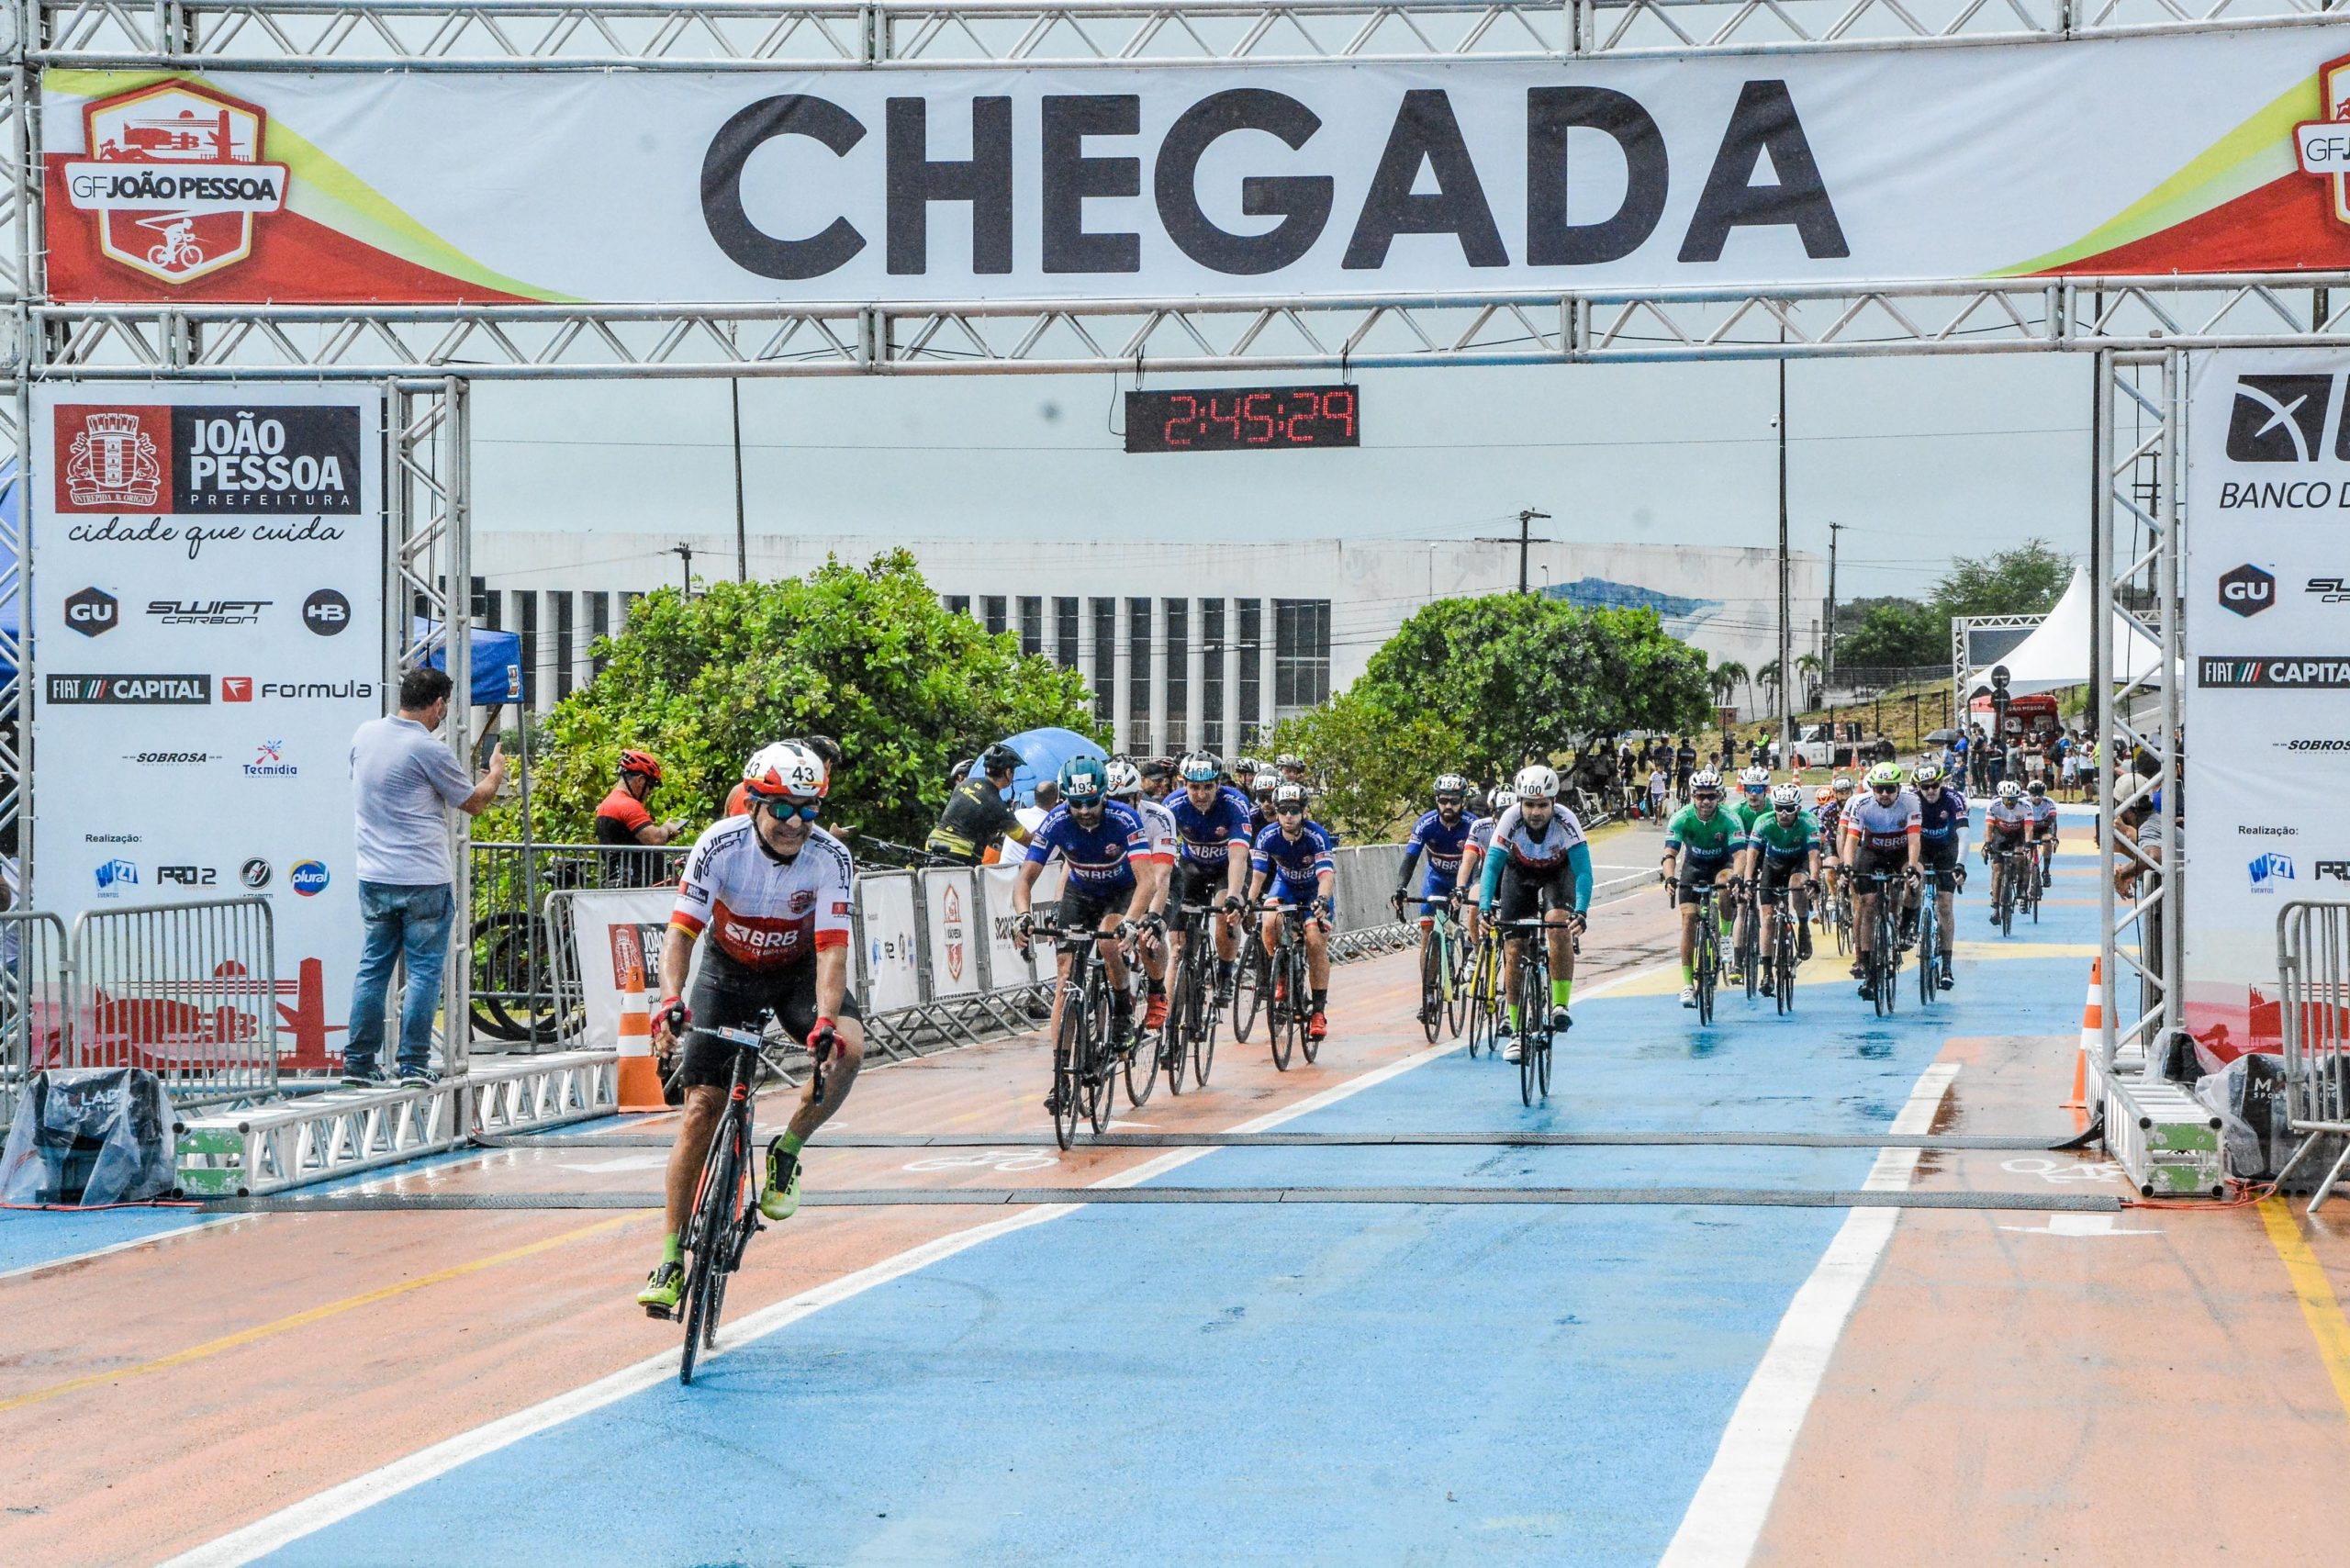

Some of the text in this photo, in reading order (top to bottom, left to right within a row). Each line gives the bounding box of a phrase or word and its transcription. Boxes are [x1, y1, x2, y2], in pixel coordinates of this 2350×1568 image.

[700, 79, 1850, 279] CHEGADA
[179, 178, 277, 201] PESSOA
[1165, 391, 1352, 445] 2:45:29
[190, 410, 285, 455] JOÃO
[191, 456, 344, 490] PESSOA
[191, 494, 350, 505] PREFEITURA
[2219, 482, 2331, 509] BANCO
[68, 515, 344, 560] cidade que cuida
[2224, 582, 2269, 599] GU
[70, 603, 112, 622] GU
[145, 601, 274, 615] SWIFT
[161, 616, 259, 625] CARBON
[2205, 662, 2233, 681] FIAT
[52, 680, 205, 699] FIAT CAPITAL
[262, 680, 372, 699] Formula
[137, 752, 207, 763] SOBROSA
[792, 767, 814, 782] 43
[1109, 774, 1123, 783] 35
[1919, 771, 1934, 780] 247
[1072, 782, 1092, 793] 193
[1442, 780, 1458, 789] 157
[1523, 785, 1542, 795] 100
[1500, 796, 1512, 805] 31
[1777, 793, 1791, 801] 221
[2238, 825, 2300, 836] Realização:
[85, 834, 142, 844] Realização:
[158, 866, 217, 885] PRO 2
[292, 872, 329, 885] plural
[1090, 865, 1124, 879] BRB
[749, 930, 799, 947] BRB
